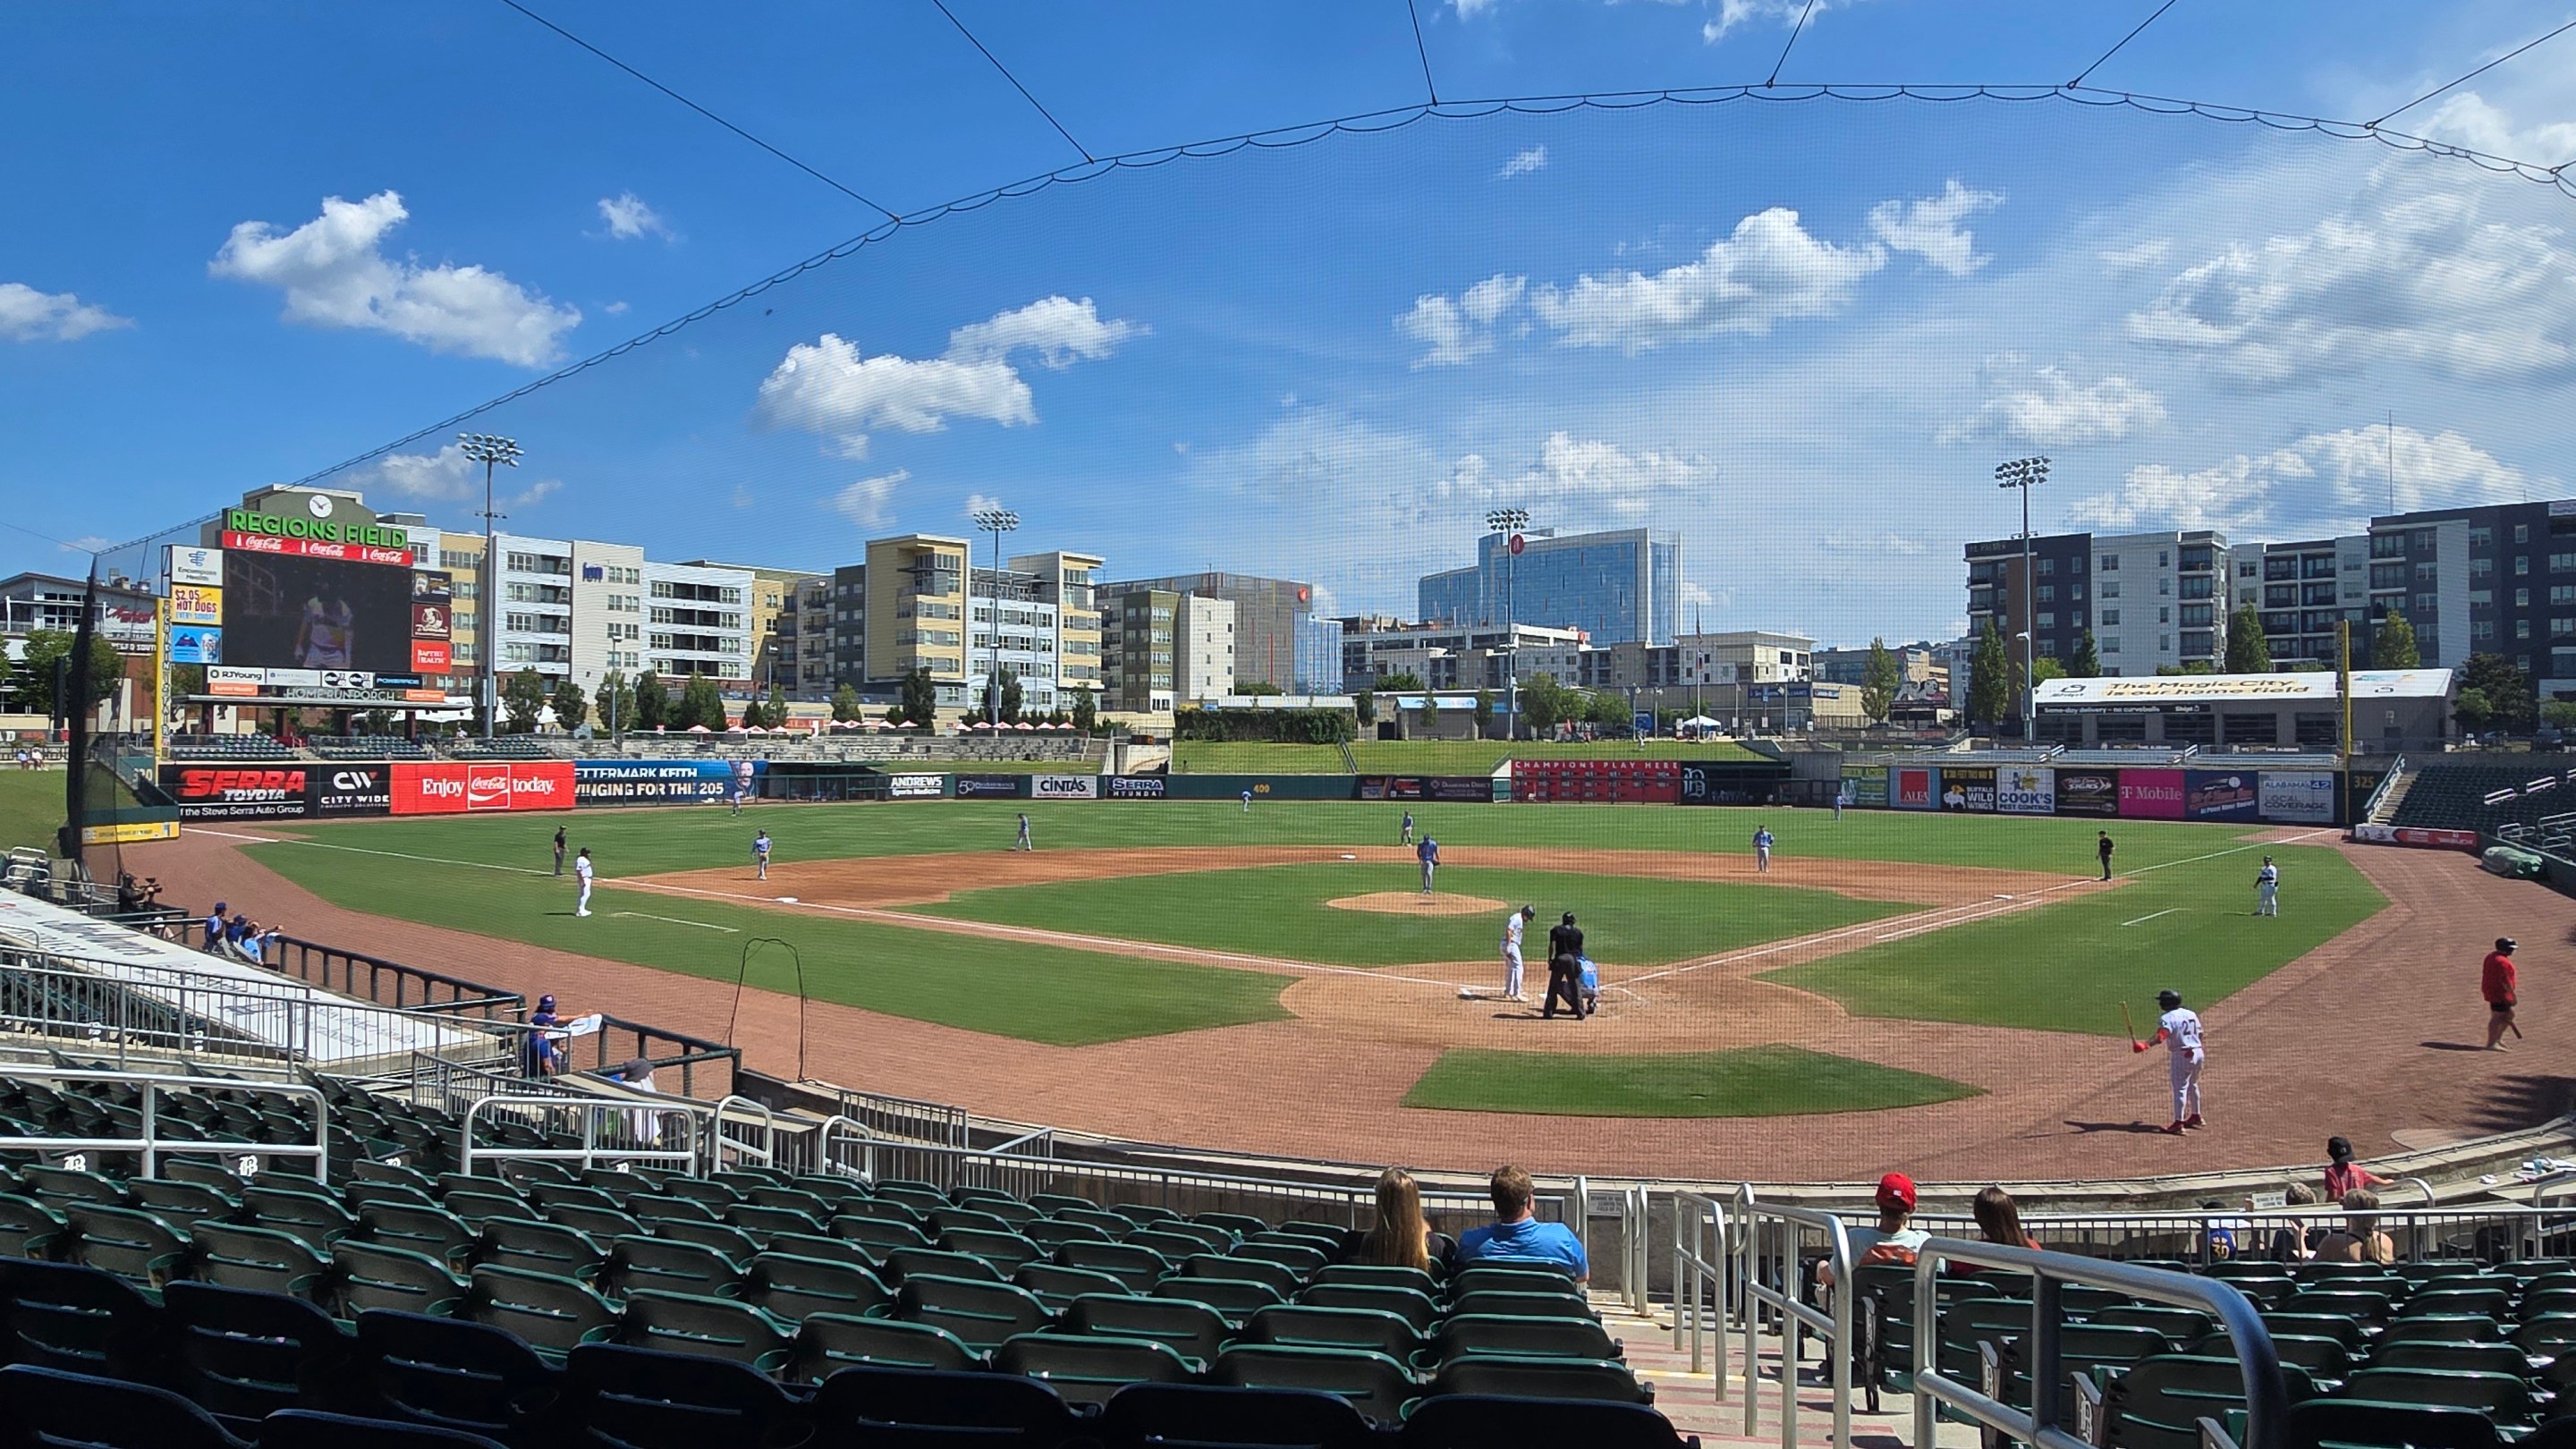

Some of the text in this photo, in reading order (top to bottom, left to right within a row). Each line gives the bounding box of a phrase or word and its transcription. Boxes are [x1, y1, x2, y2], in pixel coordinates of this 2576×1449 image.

[231, 511, 406, 548] REGIONS FIELD
[178, 566, 216, 576] Encompass
[175, 589, 200, 601] $2.05
[176, 600, 216, 613] HOT DOGS
[222, 671, 262, 680] RJYoung
[286, 688, 395, 701] HOME RUN PORCH
[1604, 761, 1634, 769] PLAY
[660, 767, 697, 777] KEITH
[179, 769, 306, 797] SERRA
[891, 776, 943, 786] ANDREWS
[1113, 779, 1163, 789] SERRA
[2354, 775, 2374, 788] 325
[422, 778, 465, 797] Enjoy
[637, 783, 665, 795] FOR
[699, 783, 724, 795] 205
[1254, 784, 1269, 793] 400
[225, 789, 285, 801] TOYOTA
[320, 796, 351, 804] CITY
[1968, 793, 1994, 801] WILD
[2265, 794, 2299, 802] LOCAL
[2264, 801, 2326, 809] COVERAGE
[185, 808, 199, 816] the
[202, 806, 228, 816] Steve
[230, 807, 254, 815] Serra
[256, 805, 275, 814] Auto
[277, 806, 304, 817] Group
[2182, 1019, 2198, 1036] 27
